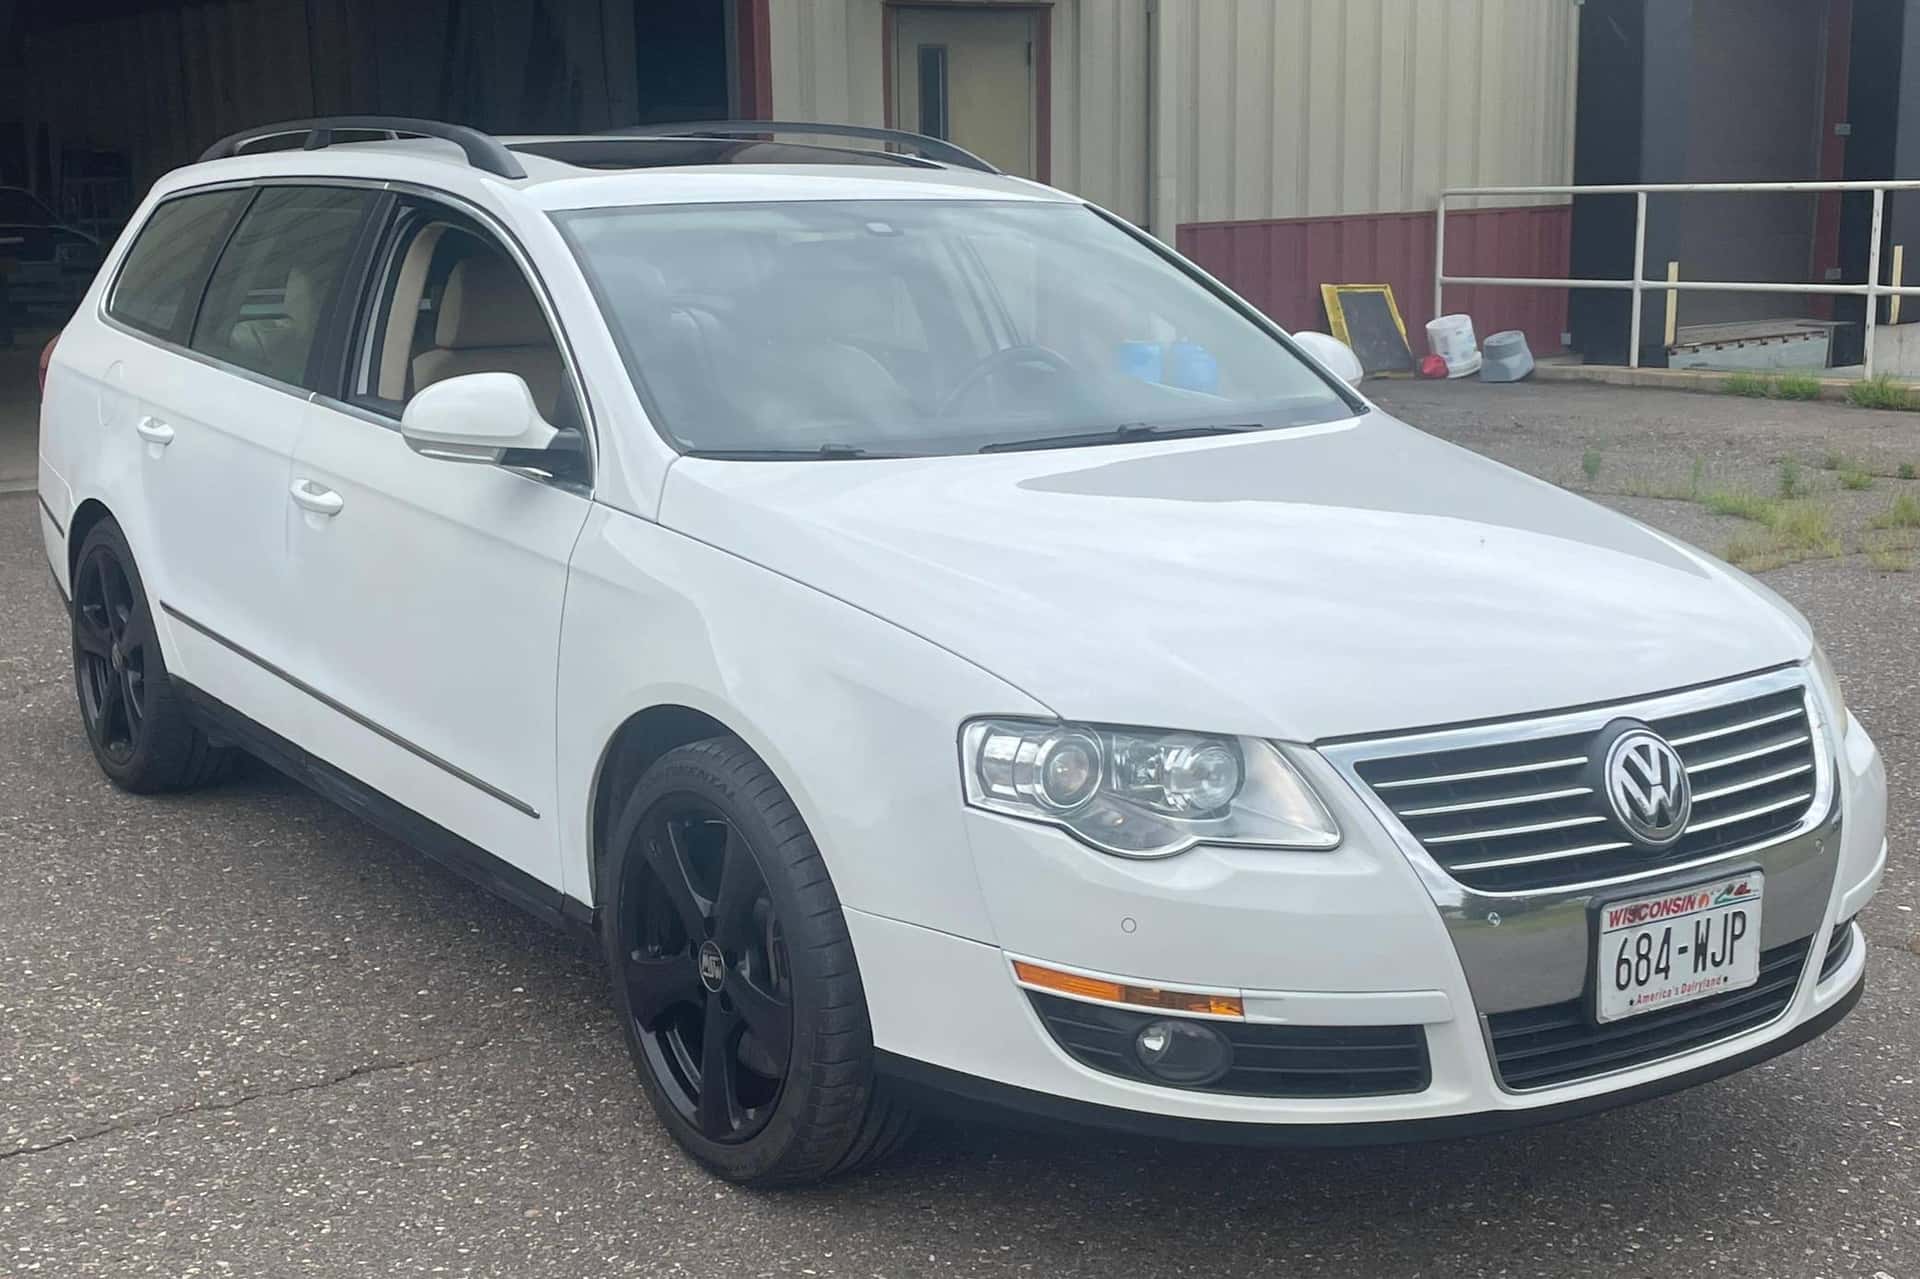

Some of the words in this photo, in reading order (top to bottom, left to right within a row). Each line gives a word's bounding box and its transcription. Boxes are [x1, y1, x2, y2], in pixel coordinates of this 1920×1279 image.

[1609, 894, 1696, 927] WISCONSIN
[1616, 910, 1746, 990] 684-WJP
[1635, 983, 1680, 1005] America's
[1680, 976, 1722, 995] Dairyland
